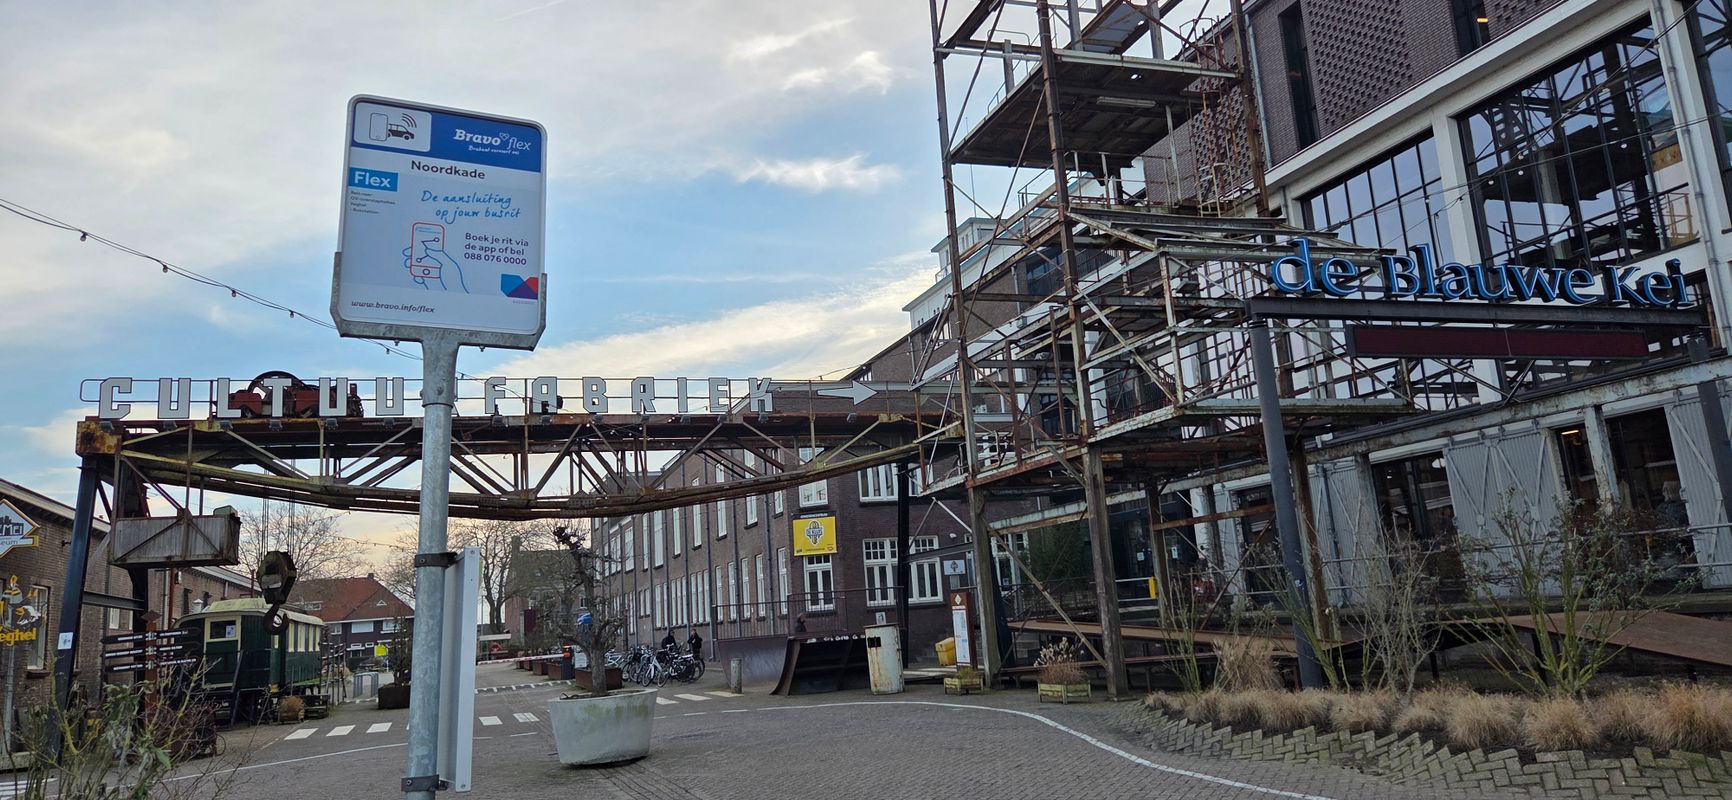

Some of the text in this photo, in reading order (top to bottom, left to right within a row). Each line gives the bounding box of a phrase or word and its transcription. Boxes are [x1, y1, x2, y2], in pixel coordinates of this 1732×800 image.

[453, 129, 532, 150] Bravo flex
[411, 160, 486, 180] Noordkade
[354, 171, 391, 188] Flex
[421, 190, 512, 209] De aansluiting
[435, 207, 521, 224] op jouw busrit
[465, 232, 529, 247] Boek je rit via
[464, 252, 527, 265] 088 076 0000
[479, 246, 496, 254] app
[510, 247, 524, 255] bel
[1270, 237, 1696, 307] de Blauwe Kei
[351, 300, 435, 314] www.bravo.info/flex
[99, 376, 773, 420] CULTUU FABRIEK
